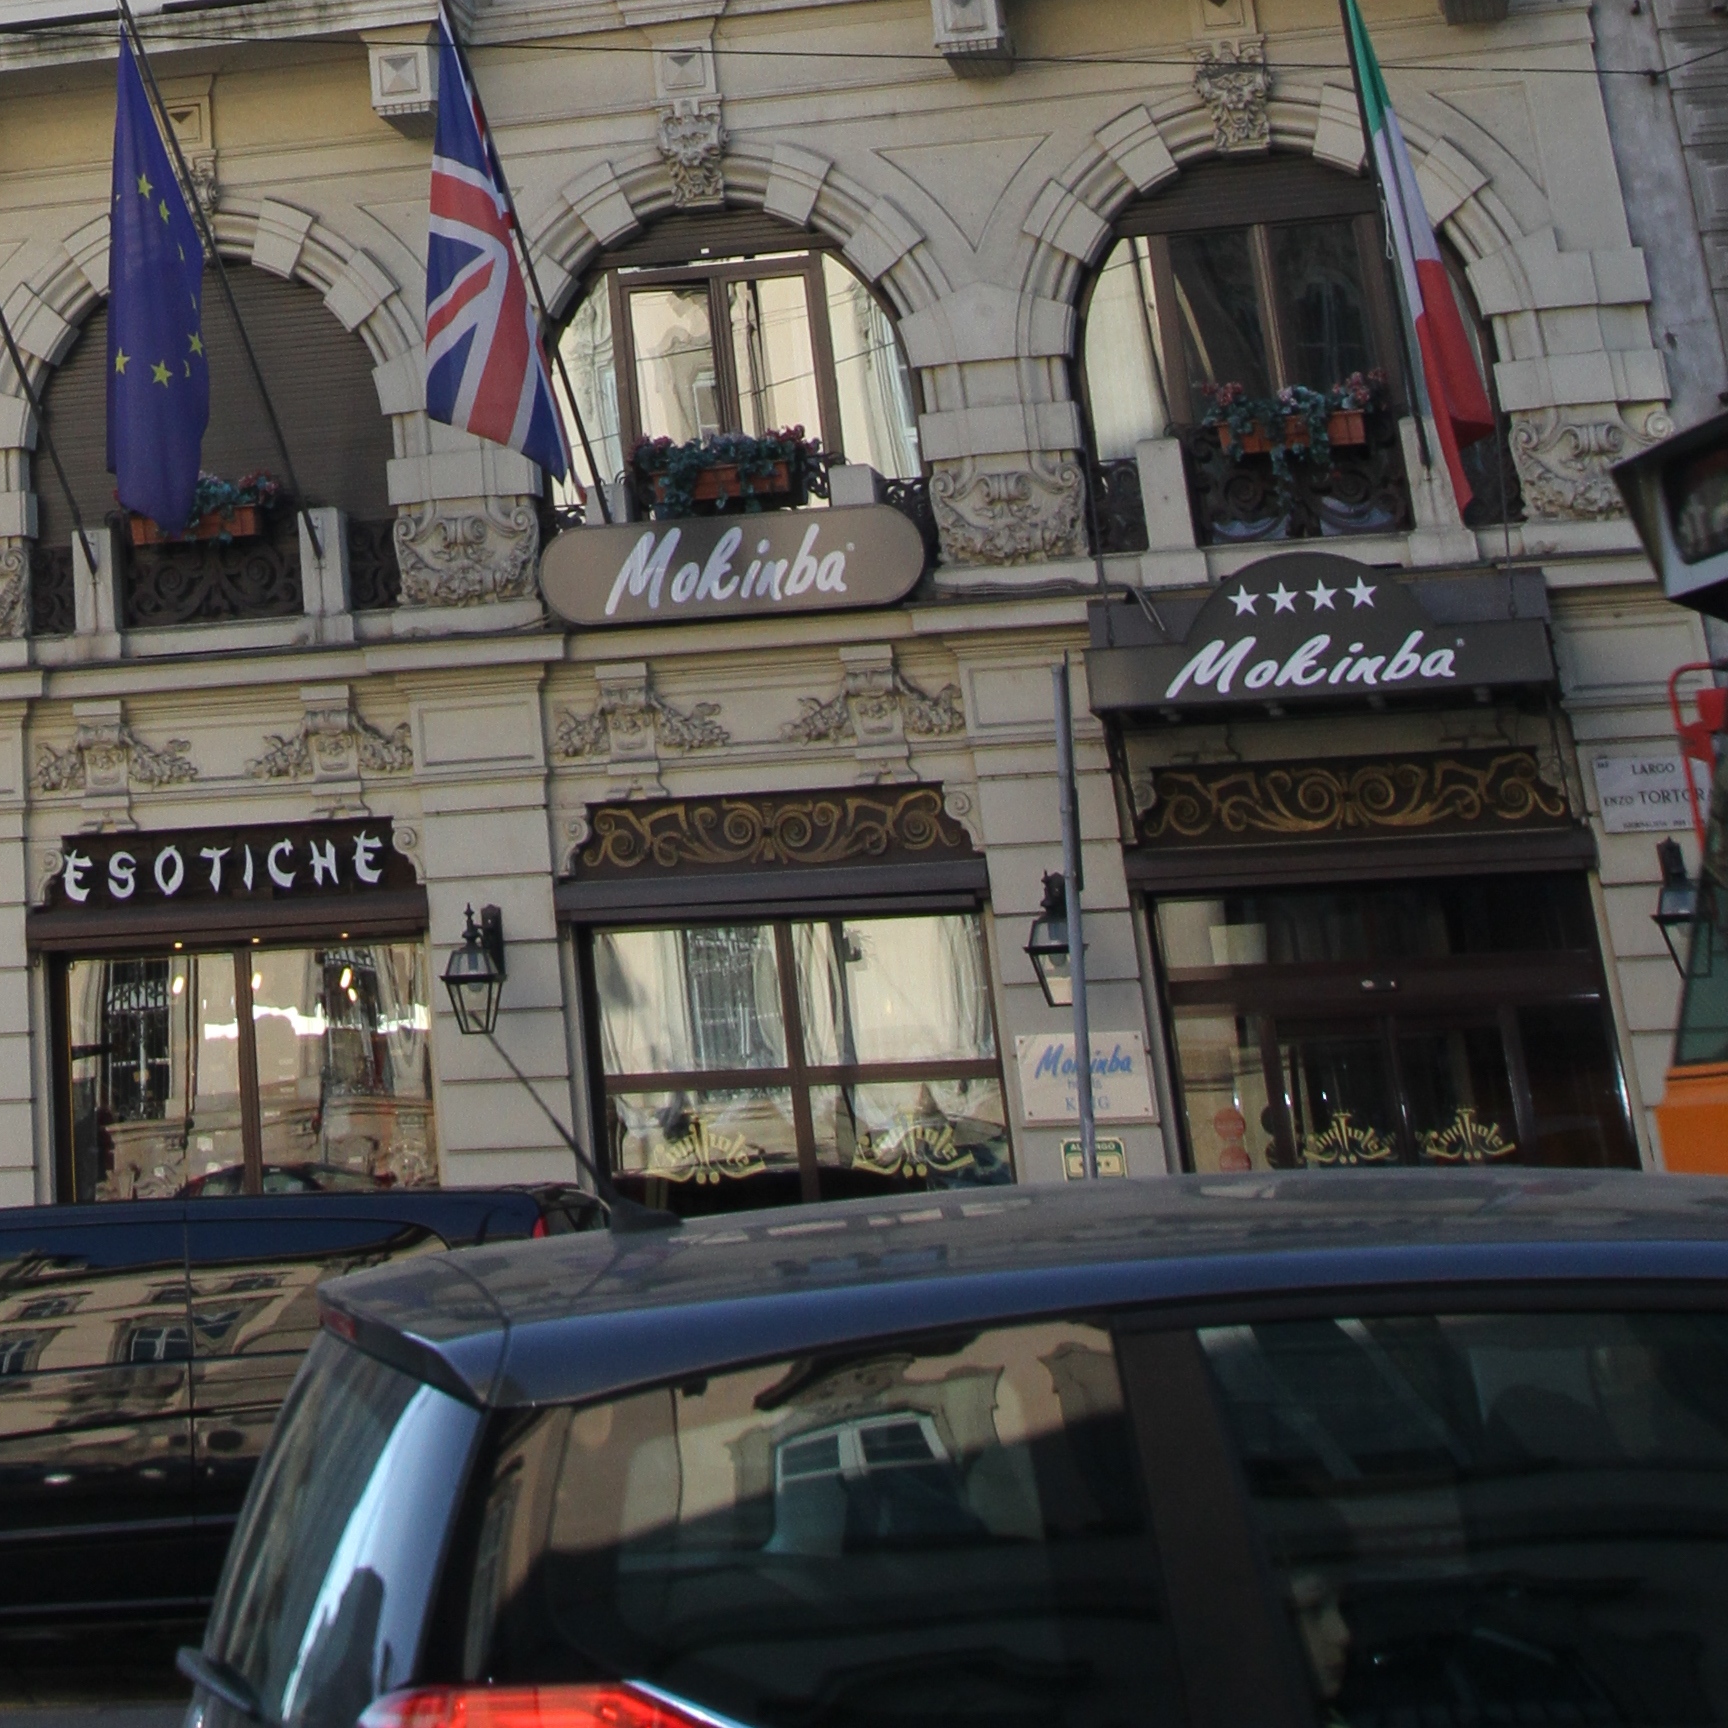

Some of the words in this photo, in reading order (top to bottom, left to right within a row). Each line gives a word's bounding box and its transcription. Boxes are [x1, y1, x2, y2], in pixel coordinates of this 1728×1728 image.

[605, 523, 847, 616] Mokinba
[1165, 629, 1456, 699] Mokinba
[1632, 762, 1675, 776] LARGO
[63, 830, 383, 902] ESOTICHE
[1034, 1043, 1133, 1079] Moinba
